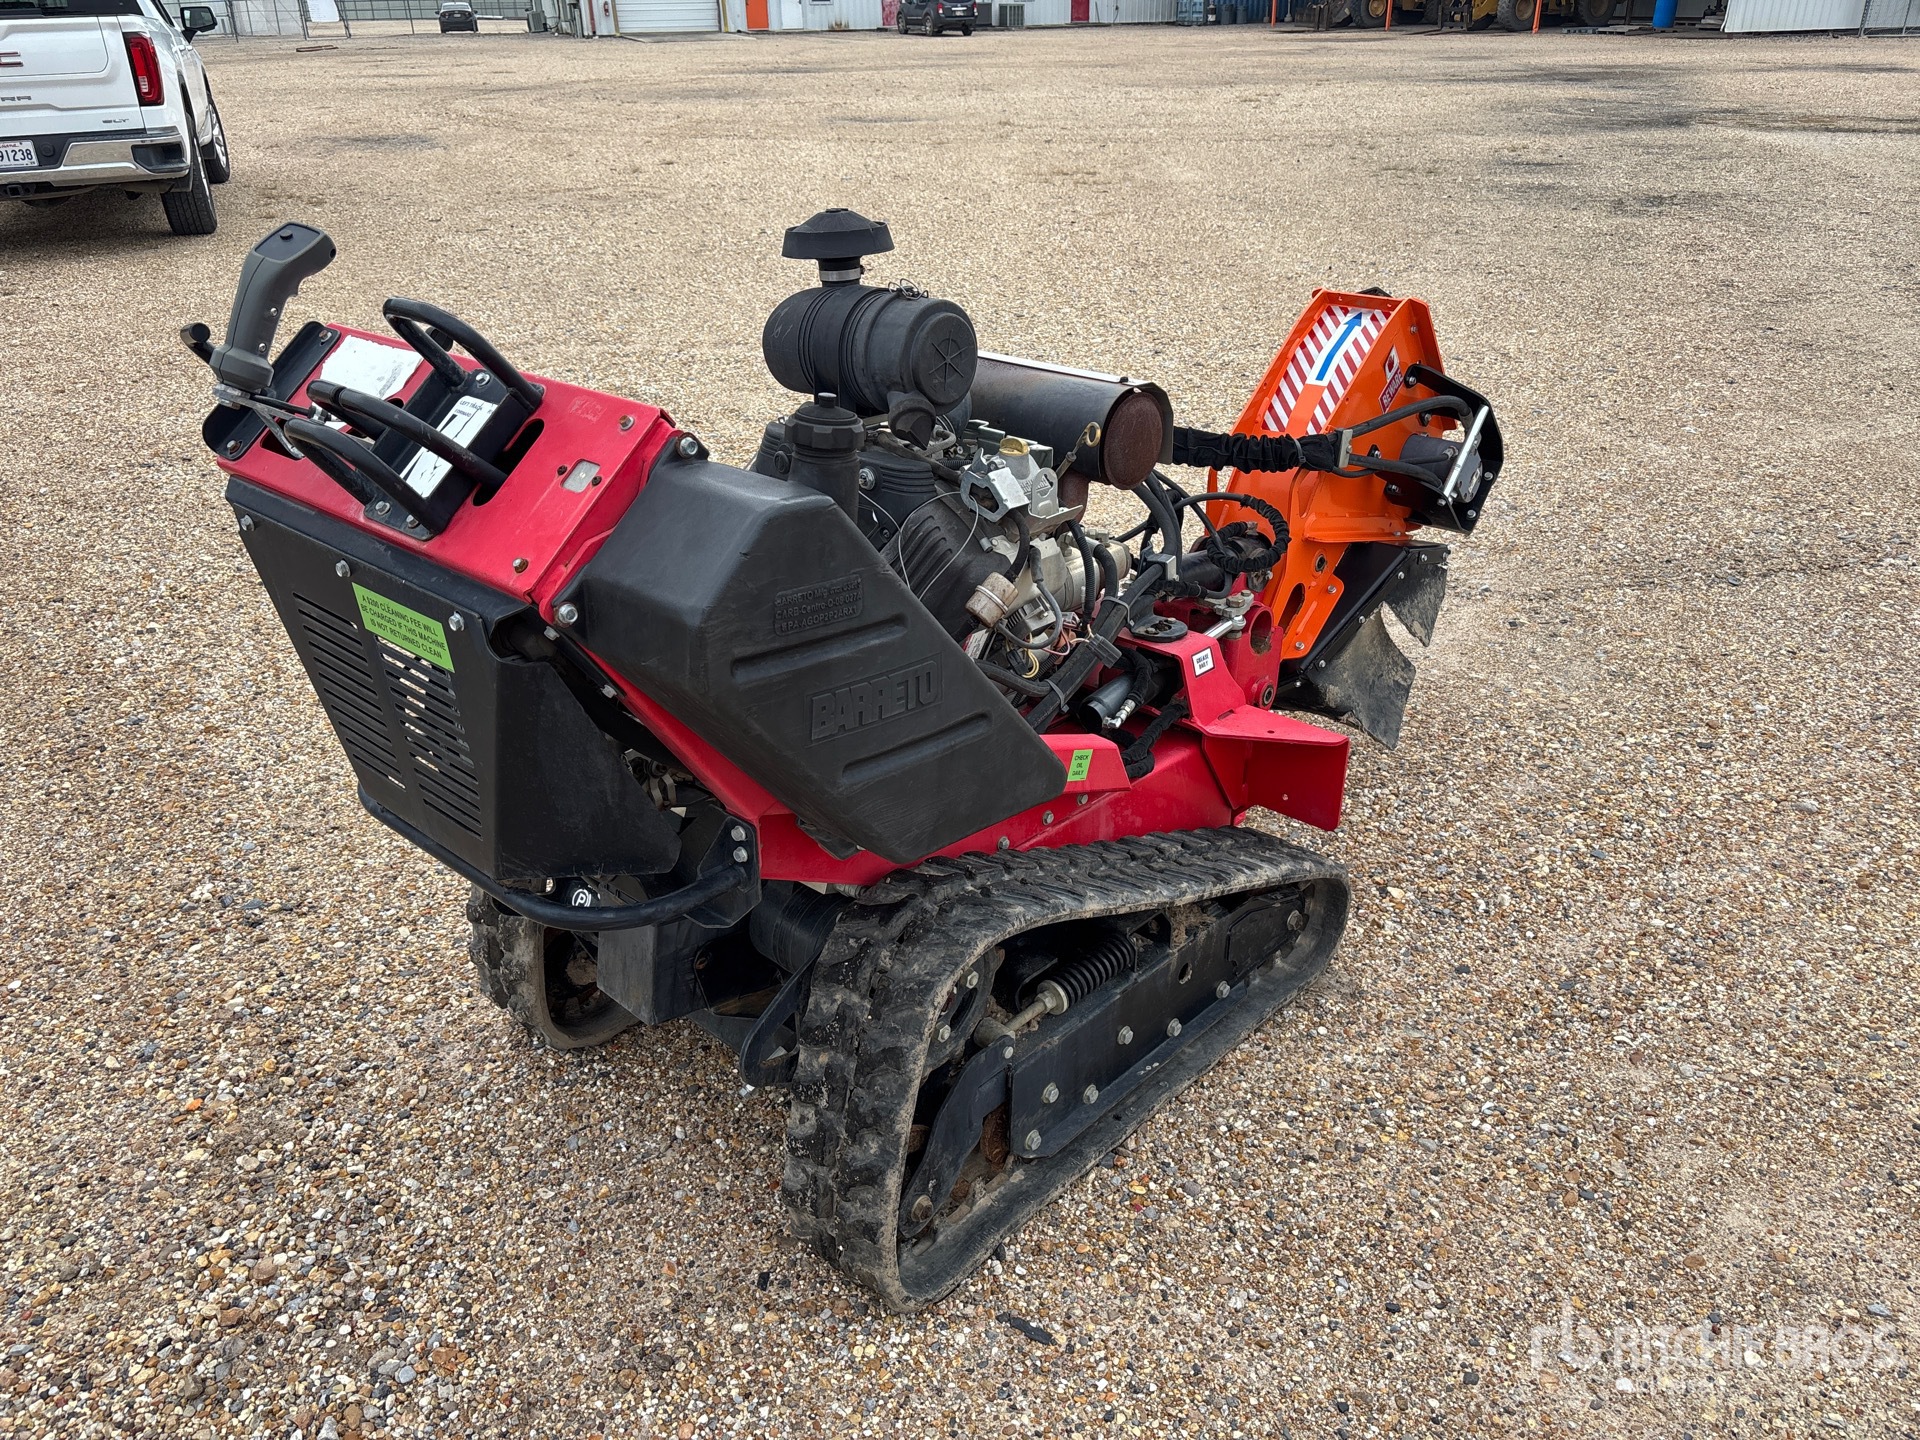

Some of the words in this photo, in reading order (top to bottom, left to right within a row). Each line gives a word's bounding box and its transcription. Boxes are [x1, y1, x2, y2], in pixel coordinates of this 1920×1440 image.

[1382, 368, 1404, 407] BEWARE
[369, 608, 397, 626] CHARGED
[404, 625, 417, 637] THIS
[418, 632, 446, 650] MACHINE
[380, 602, 410, 623] CLEANING
[410, 618, 422, 629] FEE
[422, 623, 438, 636] WILL
[377, 621, 389, 632] NOT
[389, 627, 420, 648] RETURNED
[421, 643, 442, 659] CLEAN
[811, 660, 938, 742] BARRETO
